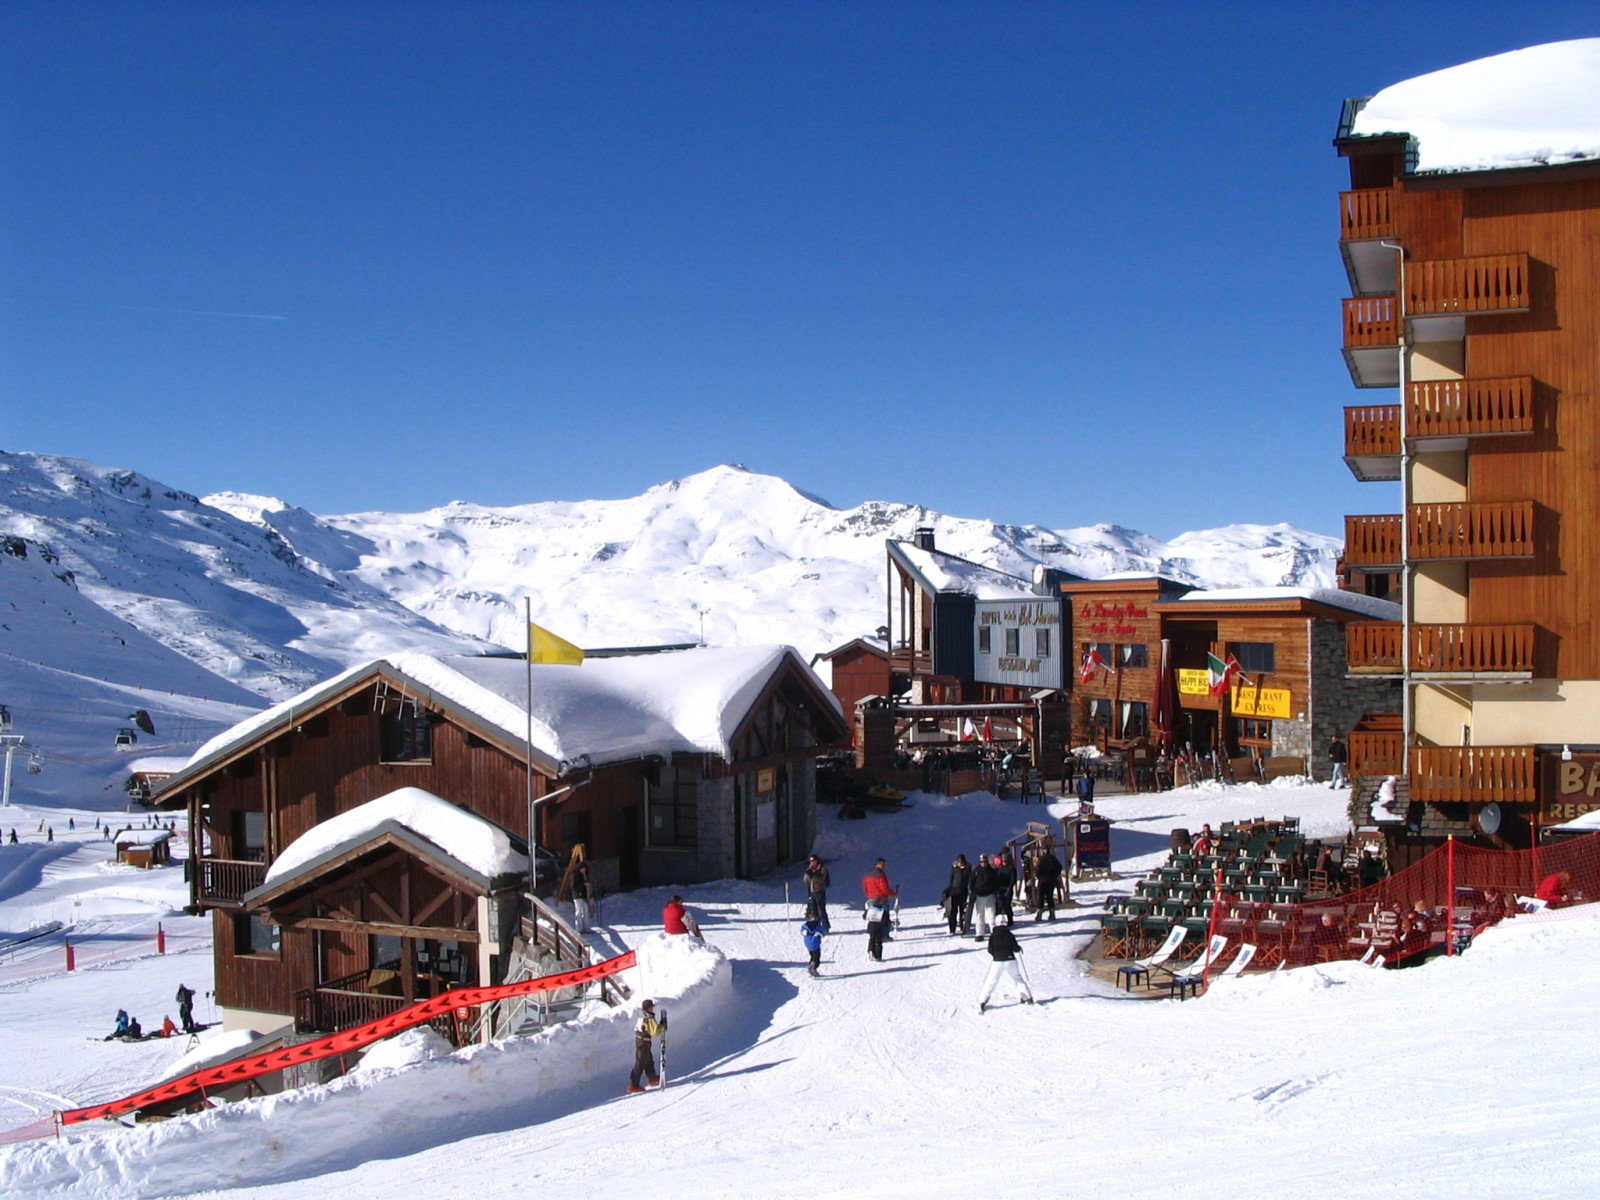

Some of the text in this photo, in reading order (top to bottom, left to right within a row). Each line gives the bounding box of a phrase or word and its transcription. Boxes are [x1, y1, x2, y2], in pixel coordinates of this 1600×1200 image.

[982, 611, 1001, 625] HOTEL
[1181, 676, 1196, 686] HAPPY
[1239, 691, 1282, 701] RESTRANT
[1245, 703, 1274, 713] EXRESS
[1550, 803, 1600, 818] RES
